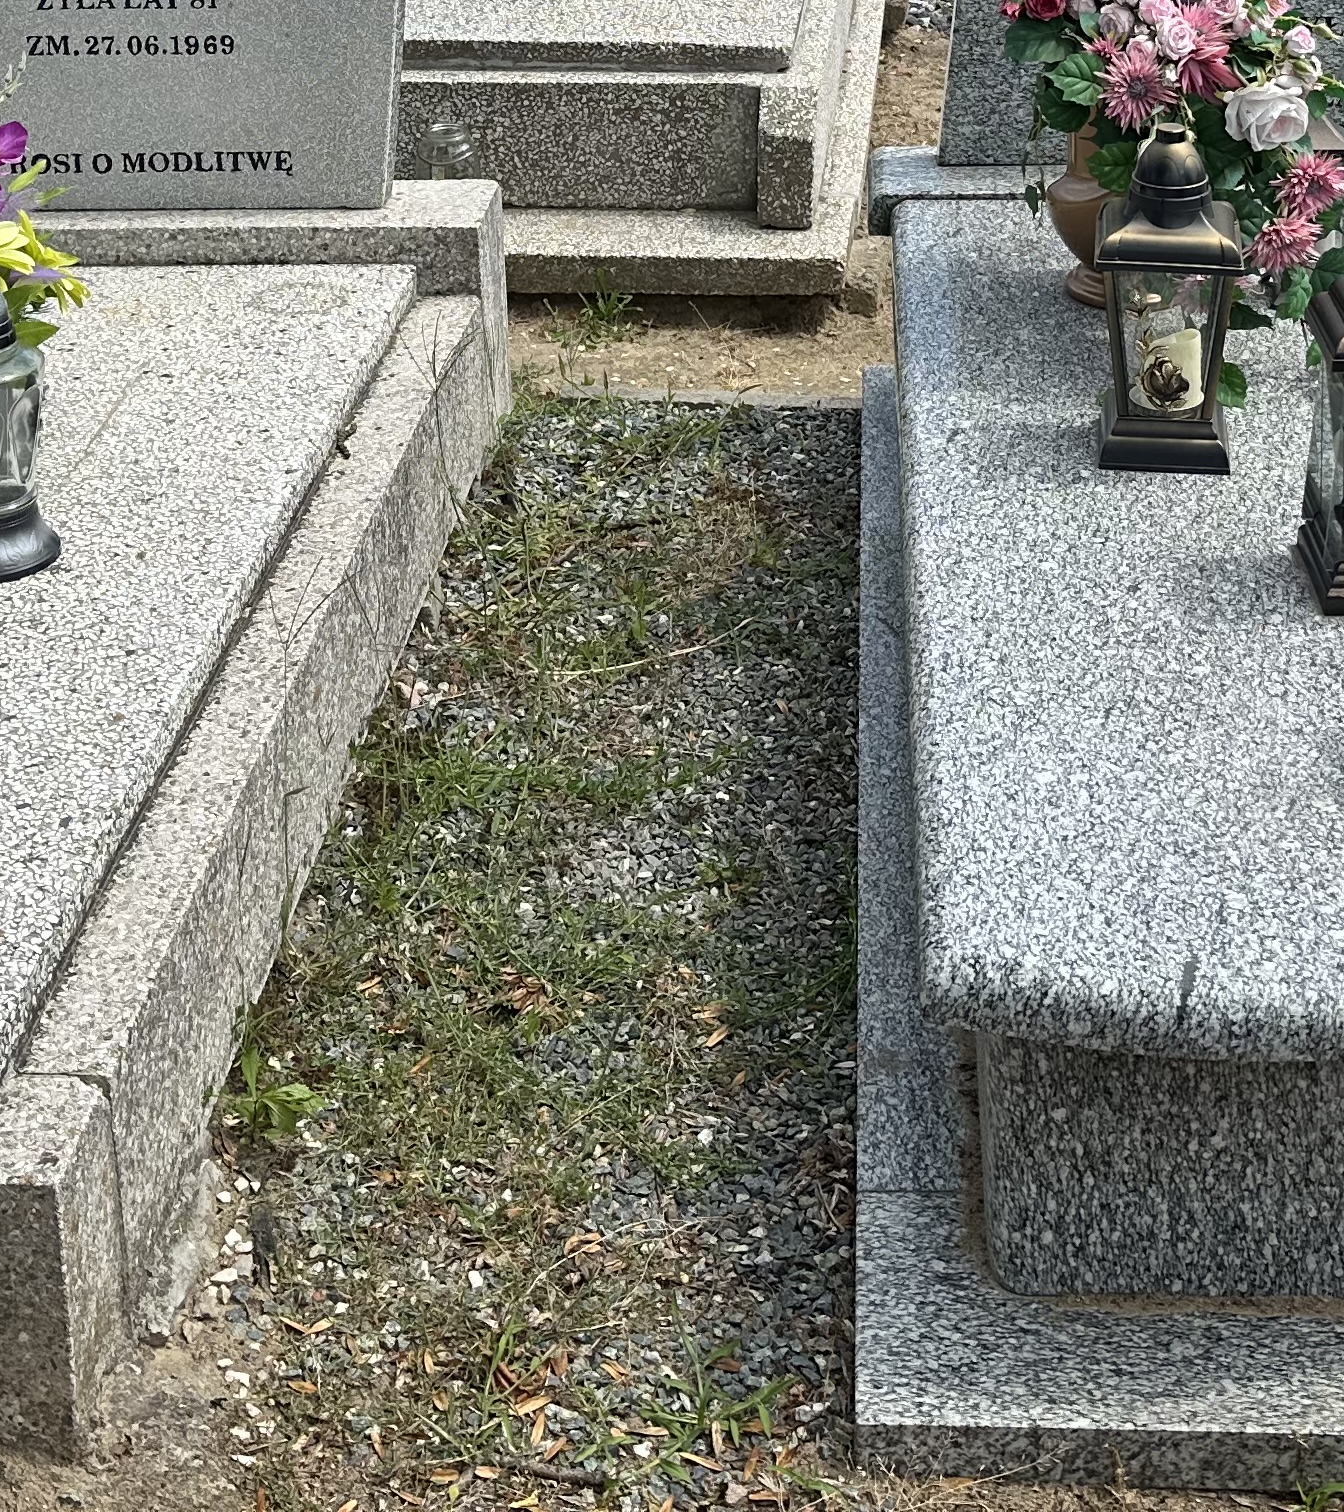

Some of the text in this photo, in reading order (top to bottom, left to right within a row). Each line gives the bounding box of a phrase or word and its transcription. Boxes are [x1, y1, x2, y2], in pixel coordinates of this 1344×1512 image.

[10, 149, 294, 178] ROSI O MODLITWĘ
